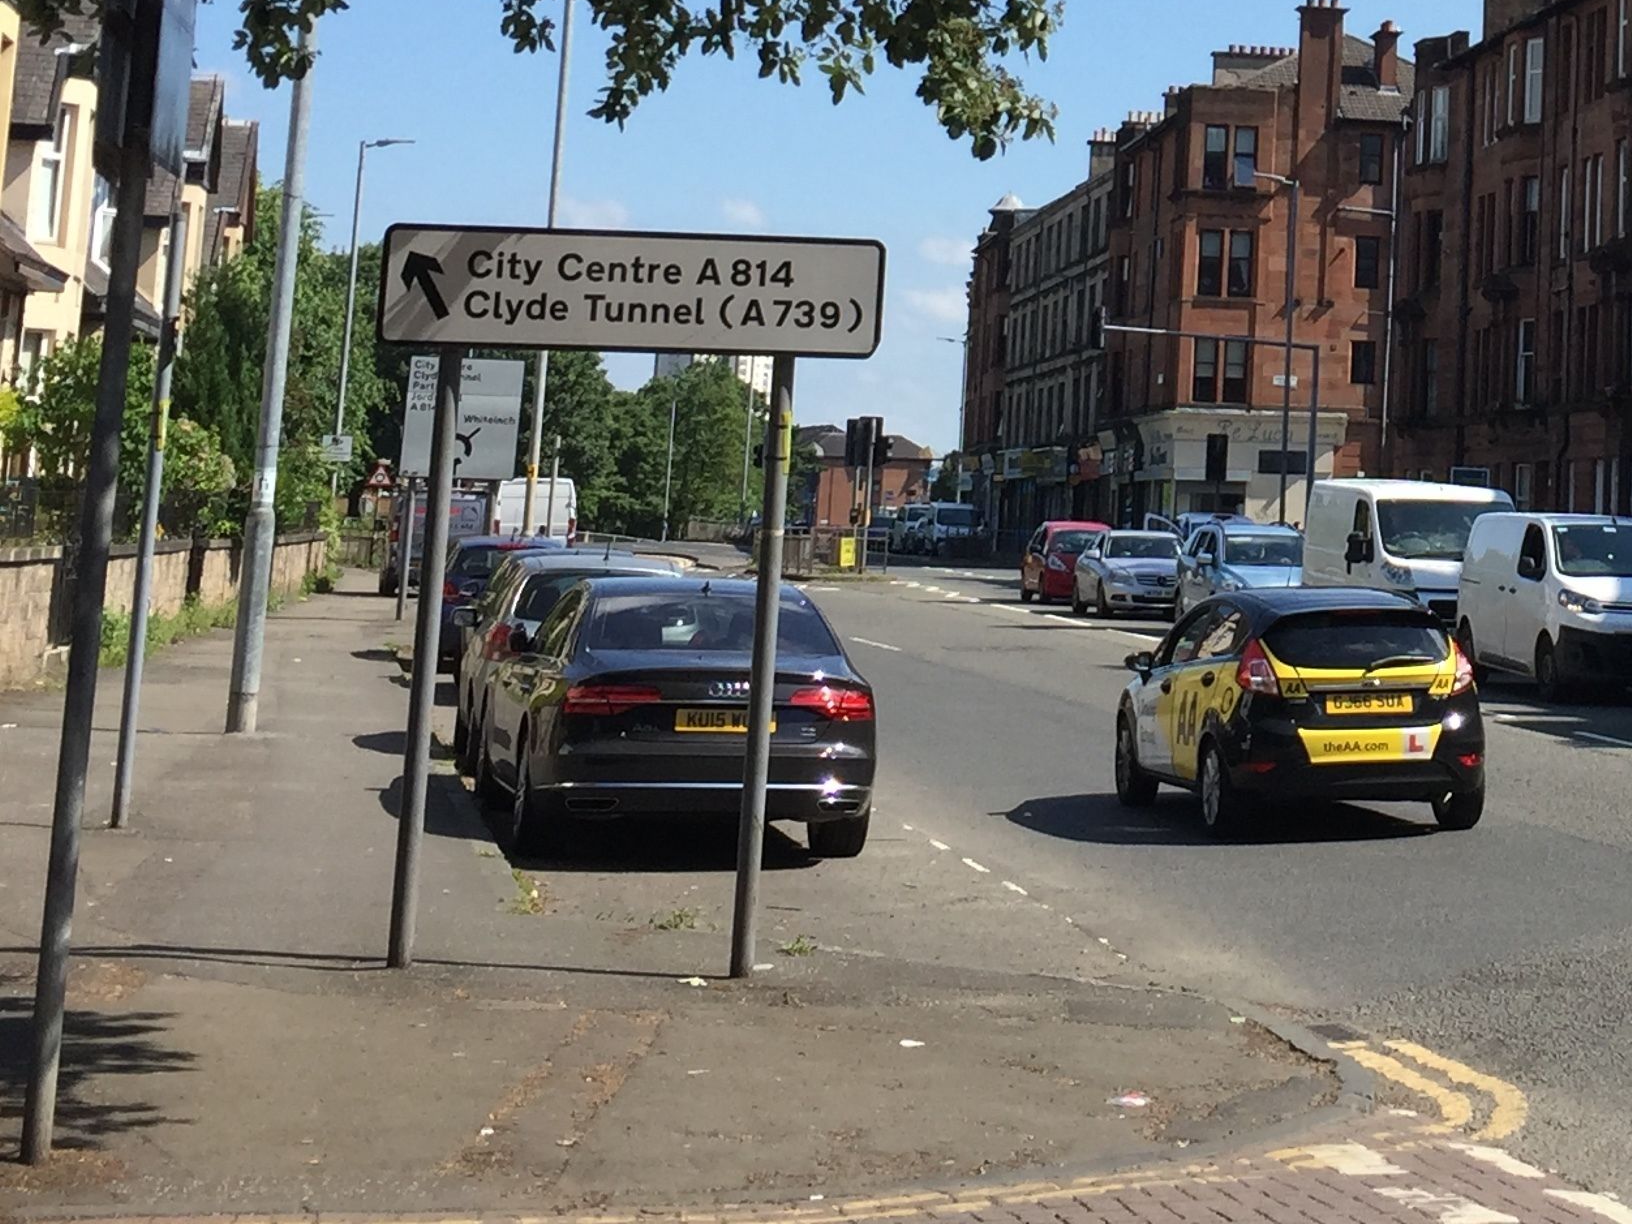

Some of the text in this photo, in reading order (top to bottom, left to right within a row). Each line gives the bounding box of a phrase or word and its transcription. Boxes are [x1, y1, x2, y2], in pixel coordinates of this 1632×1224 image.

[467, 250, 794, 287] City Centre A814
[464, 290, 863, 333] Clyde Tunnel (A739)
[415, 360, 436, 371] City
[1285, 682, 1300, 694] AA
[1435, 678, 1449, 689] AA
[686, 712, 726, 728] KU15
[1176, 689, 1198, 746] AA
[1408, 734, 1424, 753] L
